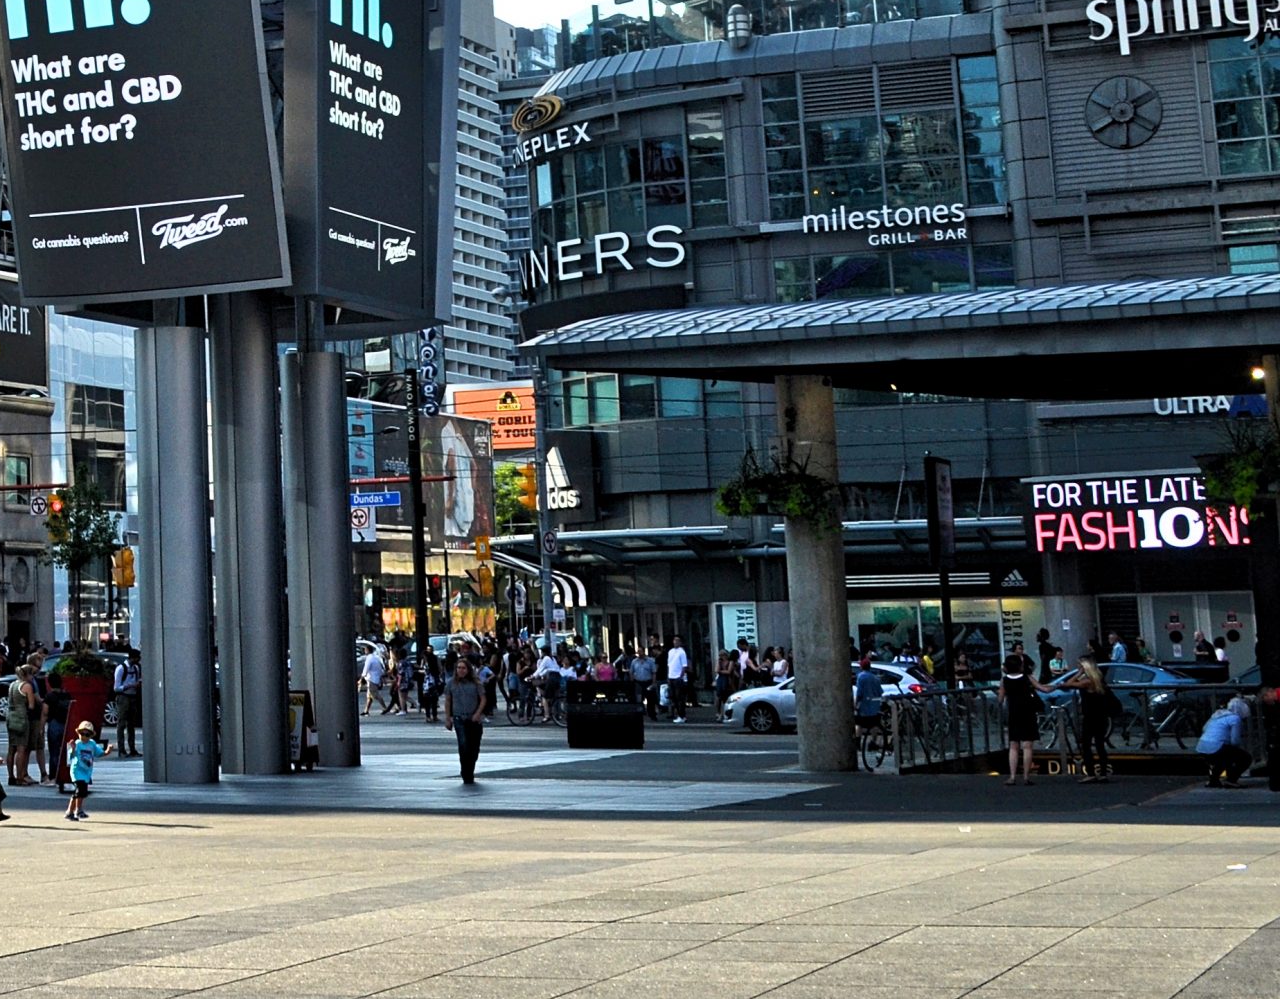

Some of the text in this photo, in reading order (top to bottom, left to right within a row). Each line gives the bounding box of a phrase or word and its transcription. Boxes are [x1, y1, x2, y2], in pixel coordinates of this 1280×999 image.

[11, 52, 126, 84] What are
[329, 39, 383, 82] What are
[15, 74, 183, 117] THC and CBD
[329, 69, 402, 117] THC and CBD
[20, 113, 137, 151] short for?
[329, 100, 385, 140] short for?
[802, 202, 966, 234] milestones
[32, 237, 46, 249] Got
[47, 234, 81, 248] cannabis
[82, 230, 129, 248] questions?
[868, 227, 968, 246] GRILL BAR
[19, 306, 32, 336] IT.
[406, 374, 416, 441] DOWNTOWN
[1153, 394, 1231, 416] ULTRA
[353, 495, 384, 505] Dundas
[1032, 482, 1082, 508] FOR
[1086, 479, 1139, 505] THE
